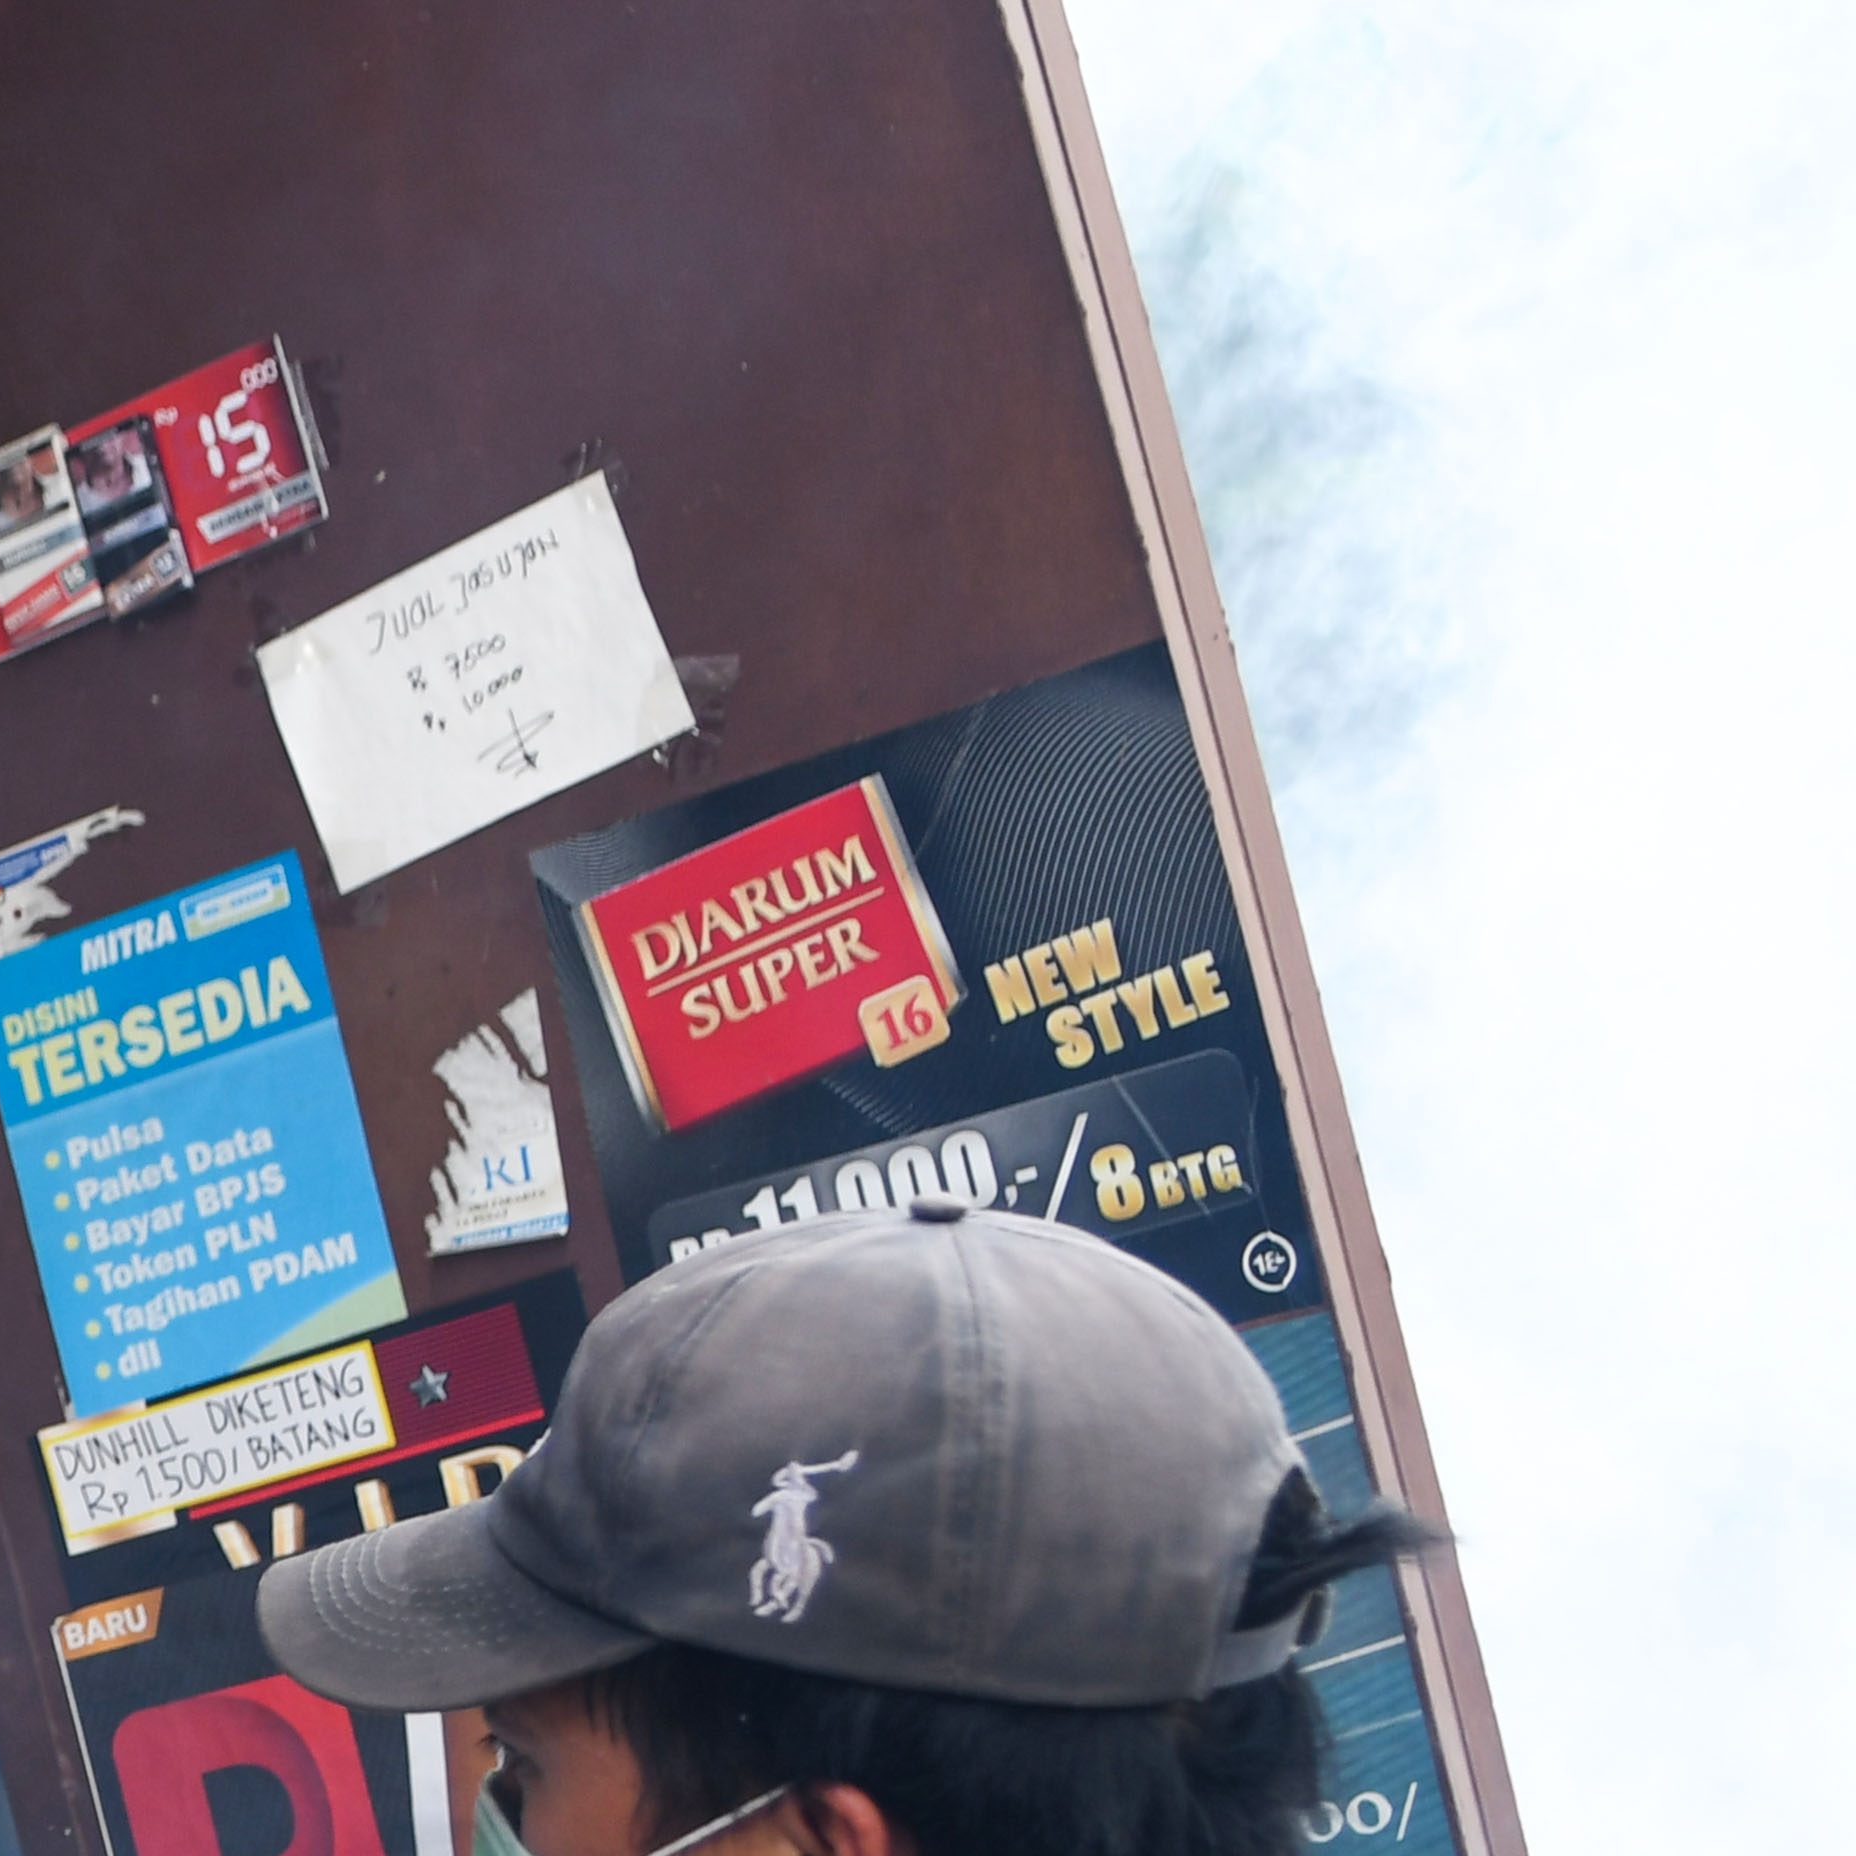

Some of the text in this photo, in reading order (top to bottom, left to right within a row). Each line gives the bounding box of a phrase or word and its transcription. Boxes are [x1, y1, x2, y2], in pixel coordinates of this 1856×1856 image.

[197, 389, 272, 479] 15
[80, 909, 178, 975] MITRA
[630, 833, 878, 981] DJARUM
[680, 917, 881, 1040] SUPER
[983, 917, 1123, 1025] NEW
[1045, 949, 1231, 1069] STYLE
[1, 985, 100, 1047] DISINI
[7, 953, 312, 1107] TERSEDIA
[877, 991, 934, 1051] 16
[65, 1116, 165, 1169] Pulsa
[74, 1126, 275, 1211] Paket Data
[1149, 1143, 1245, 1210] BTG
[84, 1161, 288, 1255] Bayar BPJS
[93, 1210, 278, 1295] Token PLN
[103, 1231, 359, 1336] Tagihan PDAM
[54, 1357, 366, 1481] DUNHILL DIKETENG
[80, 1480, 131, 1522] Rp
[64, 1603, 149, 1651] BARU
